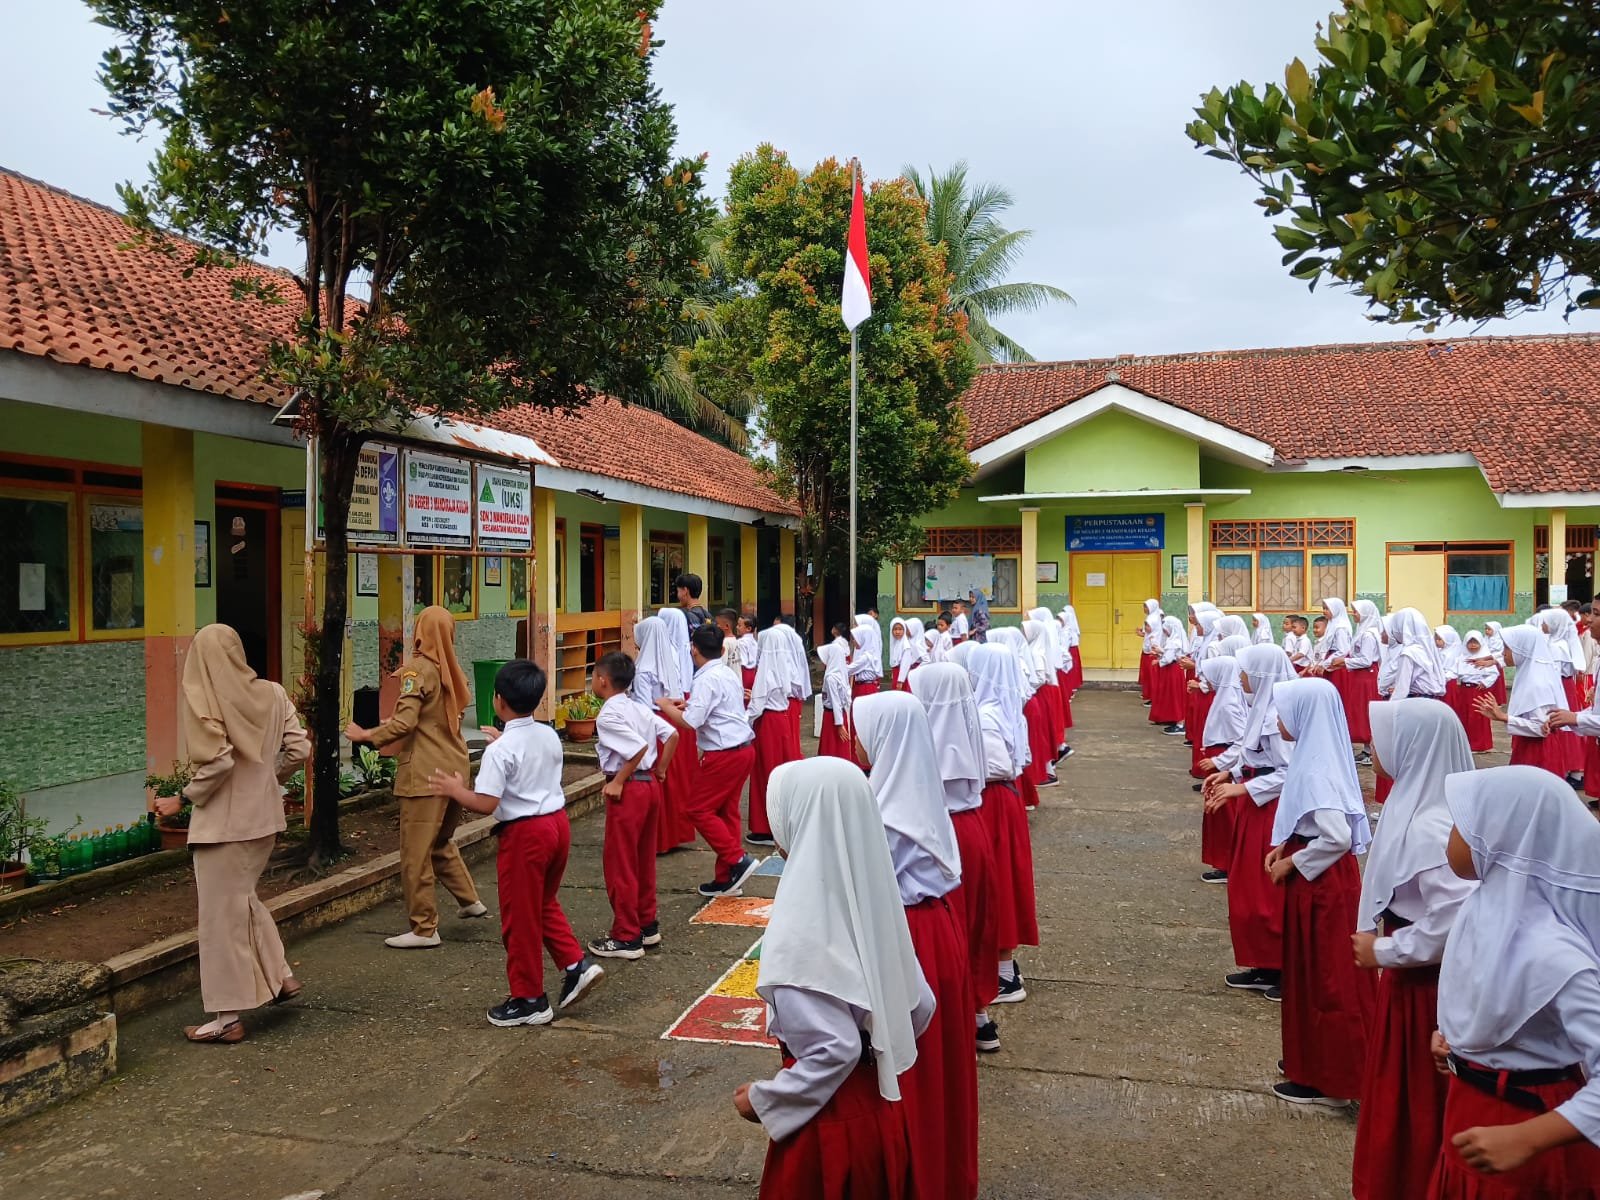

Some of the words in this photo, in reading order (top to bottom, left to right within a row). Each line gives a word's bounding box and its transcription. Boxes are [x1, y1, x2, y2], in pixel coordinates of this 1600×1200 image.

[361, 466, 378, 479] DEPAN
[415, 495, 430, 510] NEGERI
[502, 488, 523, 511] (UKS)
[480, 510, 490, 522] SDN
[517, 514, 530, 526] KULON
[482, 524, 506, 533] KECAMATAN
[507, 526, 528, 535] MANDIRAJA
